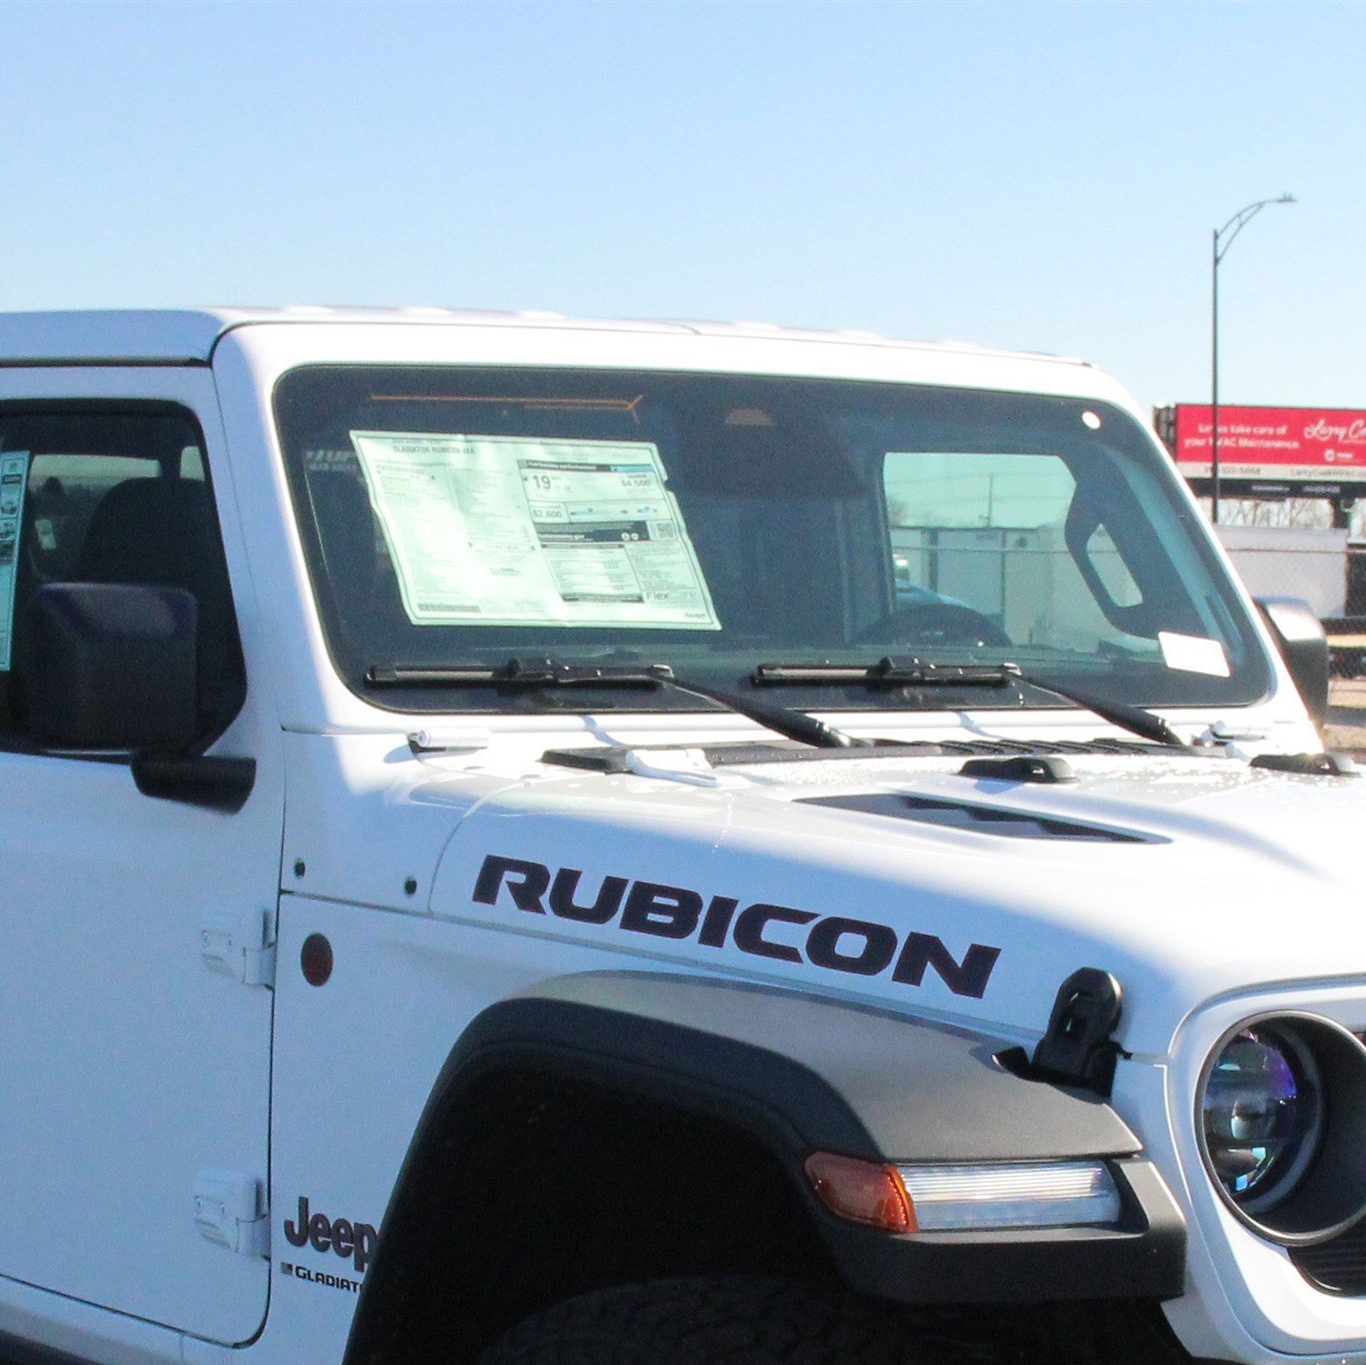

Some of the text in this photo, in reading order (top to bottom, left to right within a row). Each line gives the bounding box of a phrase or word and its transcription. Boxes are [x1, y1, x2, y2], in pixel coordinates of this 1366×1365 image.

[1230, 425, 1251, 434] take
[1253, 427, 1275, 435] care
[1276, 425, 1287, 435] of
[1184, 438, 1206, 448] your
[532, 475, 551, 490] 19
[472, 855, 1001, 1000] RUBICON
[284, 1196, 379, 1273] Jeep
[295, 1266, 363, 1293] GLADIAT
